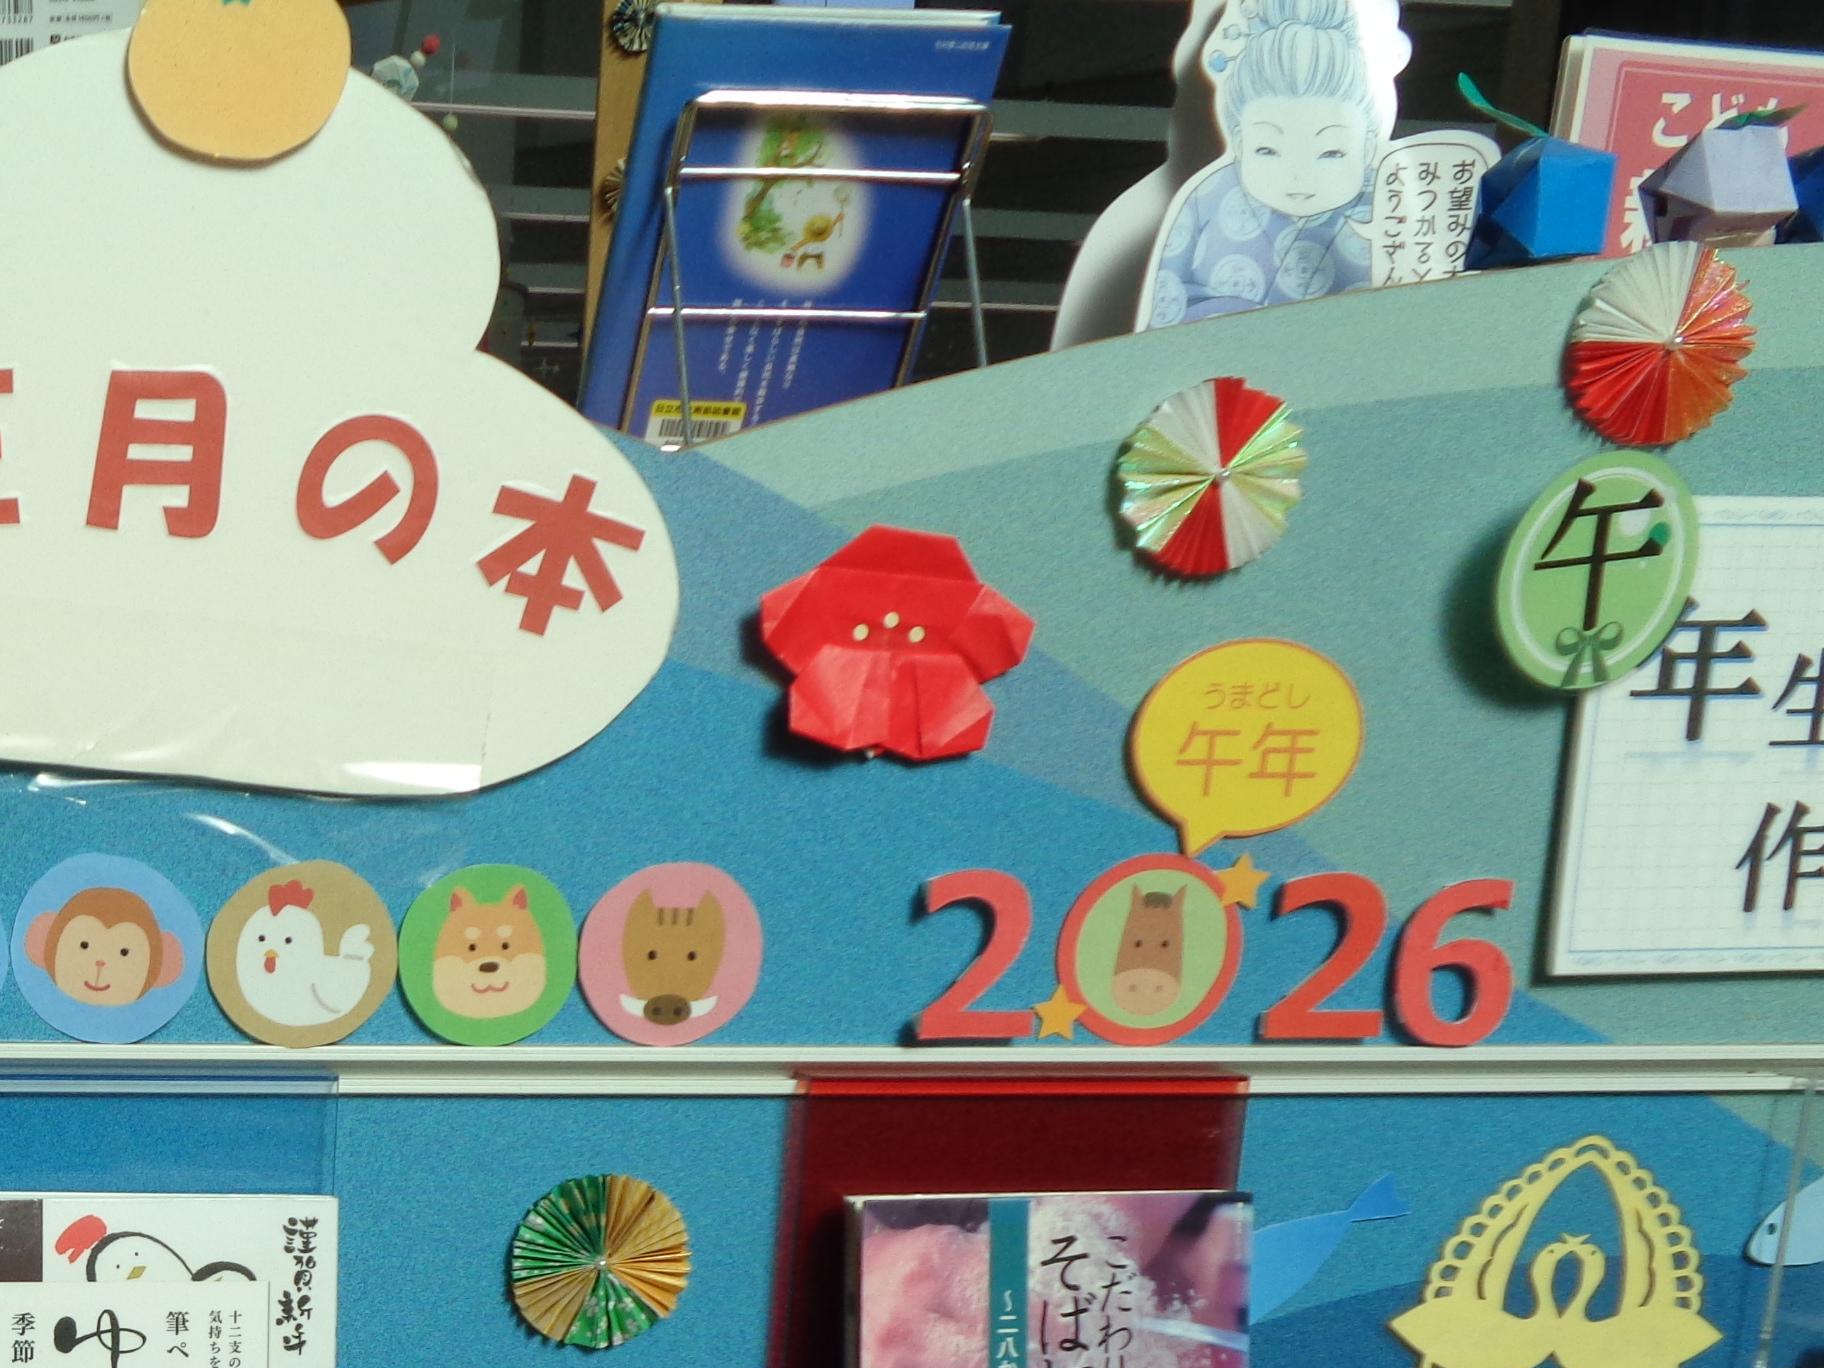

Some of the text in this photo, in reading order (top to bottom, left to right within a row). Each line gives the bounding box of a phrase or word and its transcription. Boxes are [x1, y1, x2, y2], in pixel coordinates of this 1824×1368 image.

[1652, 92, 1789, 149] こど
[1533, 479, 1667, 632] 午
[1203, 682, 1312, 713] うまどし
[1176, 724, 1320, 798] 午年
